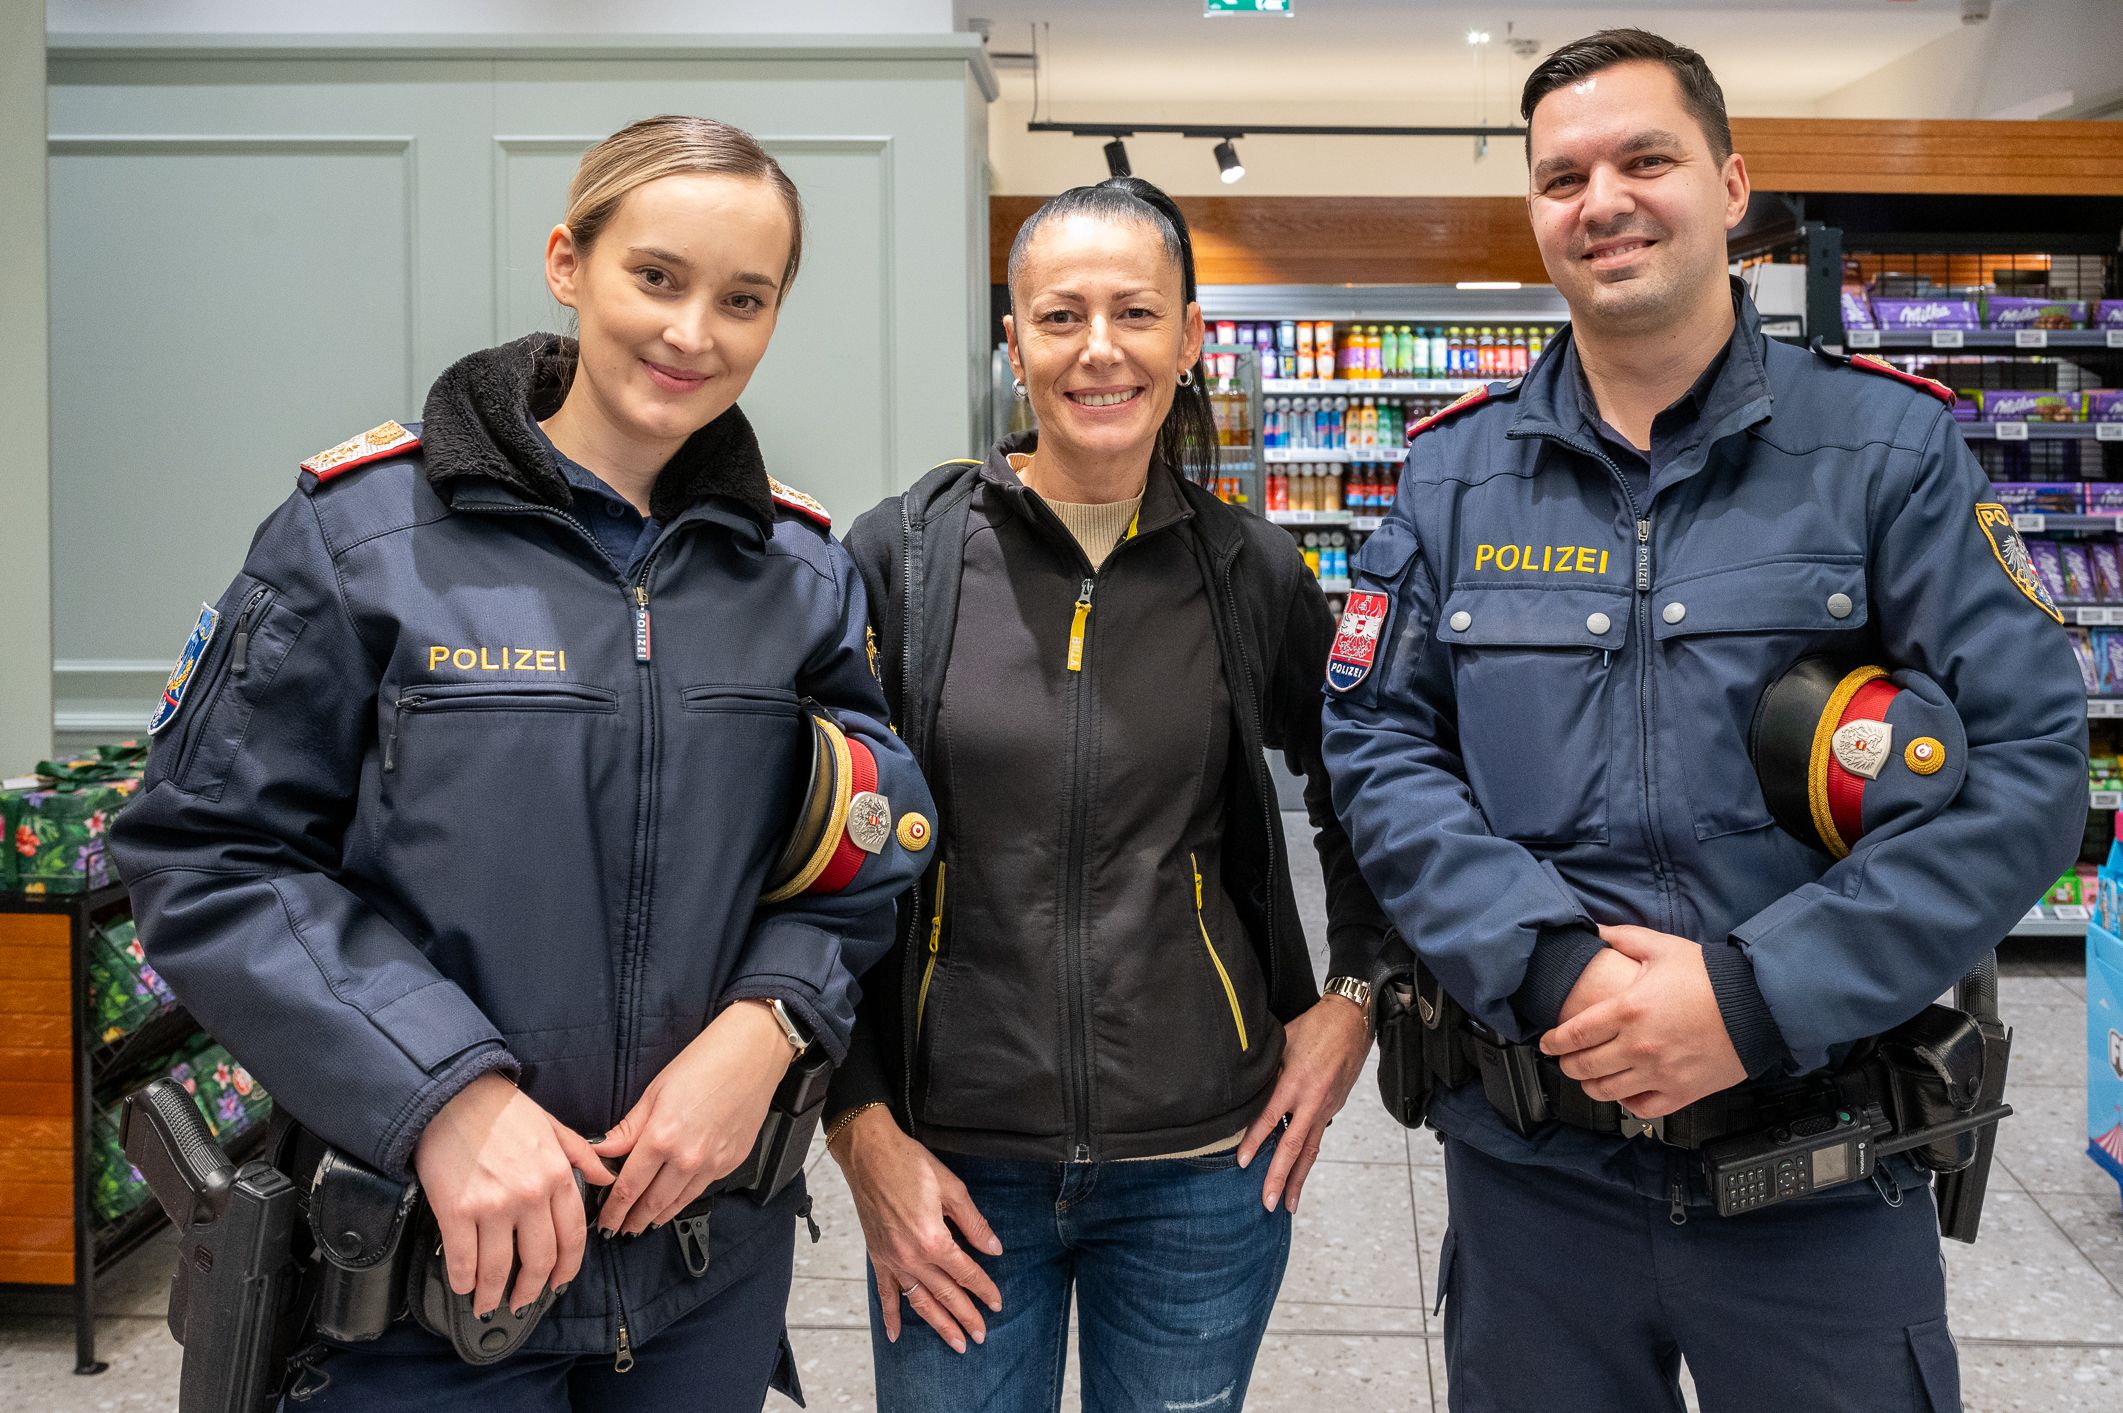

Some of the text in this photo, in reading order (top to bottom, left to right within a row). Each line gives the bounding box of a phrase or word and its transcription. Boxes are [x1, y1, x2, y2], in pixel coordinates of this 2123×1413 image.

[1474, 544, 1609, 574] POLIZEI
[1638, 548, 1648, 588] POLIZEI
[636, 612, 647, 658] POLIZEI
[429, 645, 567, 672] POLIZEI
[1330, 662, 1363, 678] POLIZEI
